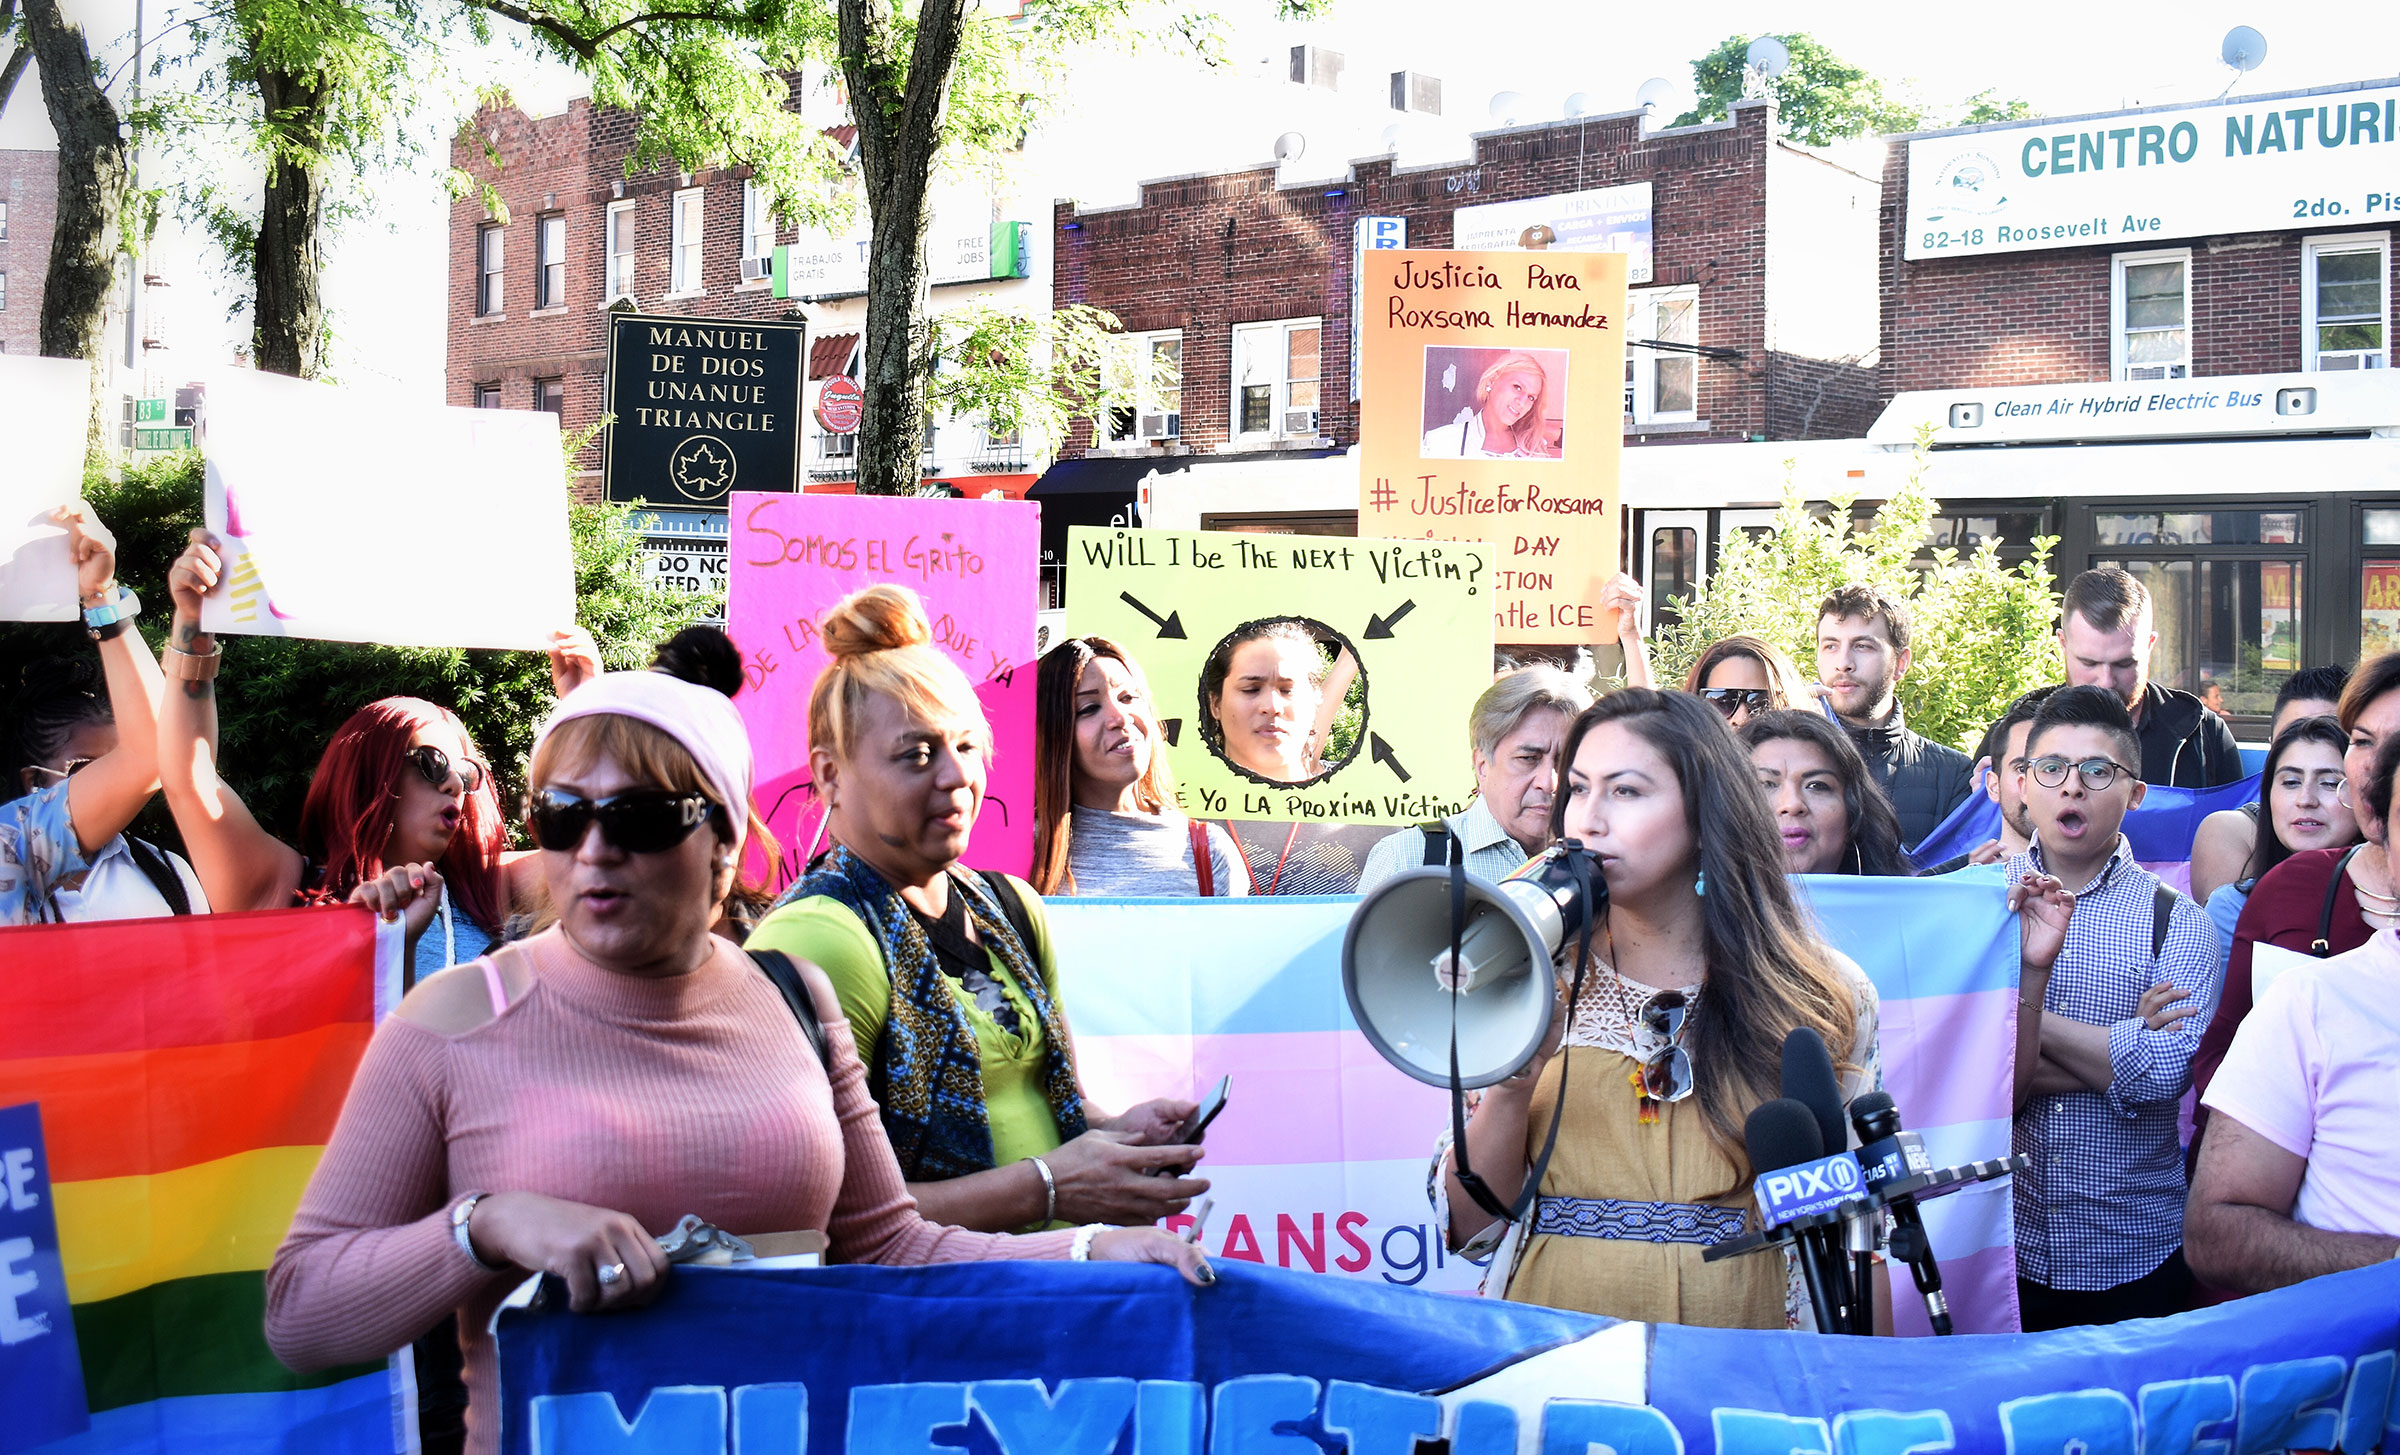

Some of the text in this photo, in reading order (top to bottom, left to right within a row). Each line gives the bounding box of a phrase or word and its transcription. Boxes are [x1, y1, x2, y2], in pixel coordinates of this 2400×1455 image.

[2021, 99, 2400, 178] CENTRO NATURI
[2293, 197, 2350, 218] 2do.
[957, 237, 984, 249] FREE
[1922, 215, 2162, 249] 82-18 Roosevelt Ave
[792, 253, 843, 266] TRABAJOS
[957, 253, 984, 265] JOBS
[792, 270, 825, 281] GRATIS
[1394, 260, 1581, 291] Justicia Para
[1389, 296, 1608, 329] Roxsana Hernandez
[649, 327, 768, 351] MANUEL
[651, 354, 764, 378] DE DIOS
[648, 381, 766, 404] UNANUE
[1994, 391, 2263, 417] Clean Air Hybrid Electric Bus
[139, 402, 151, 420] 83
[636, 408, 775, 432] TRIANGLE
[867, 540, 895, 573] EL
[1165, 537, 1180, 566] I
[1192, 539, 1225, 569] be
[1514, 535, 1560, 556] DAY
[659, 556, 689, 572] DO
[1495, 571, 1552, 591] TION
[1550, 603, 1594, 628] ICE
[743, 647, 779, 692] DE
[933, 613, 979, 659] QUE
[985, 650, 1014, 688] YA
[681, 796, 707, 826] DG
[1244, 793, 1271, 815] LA
